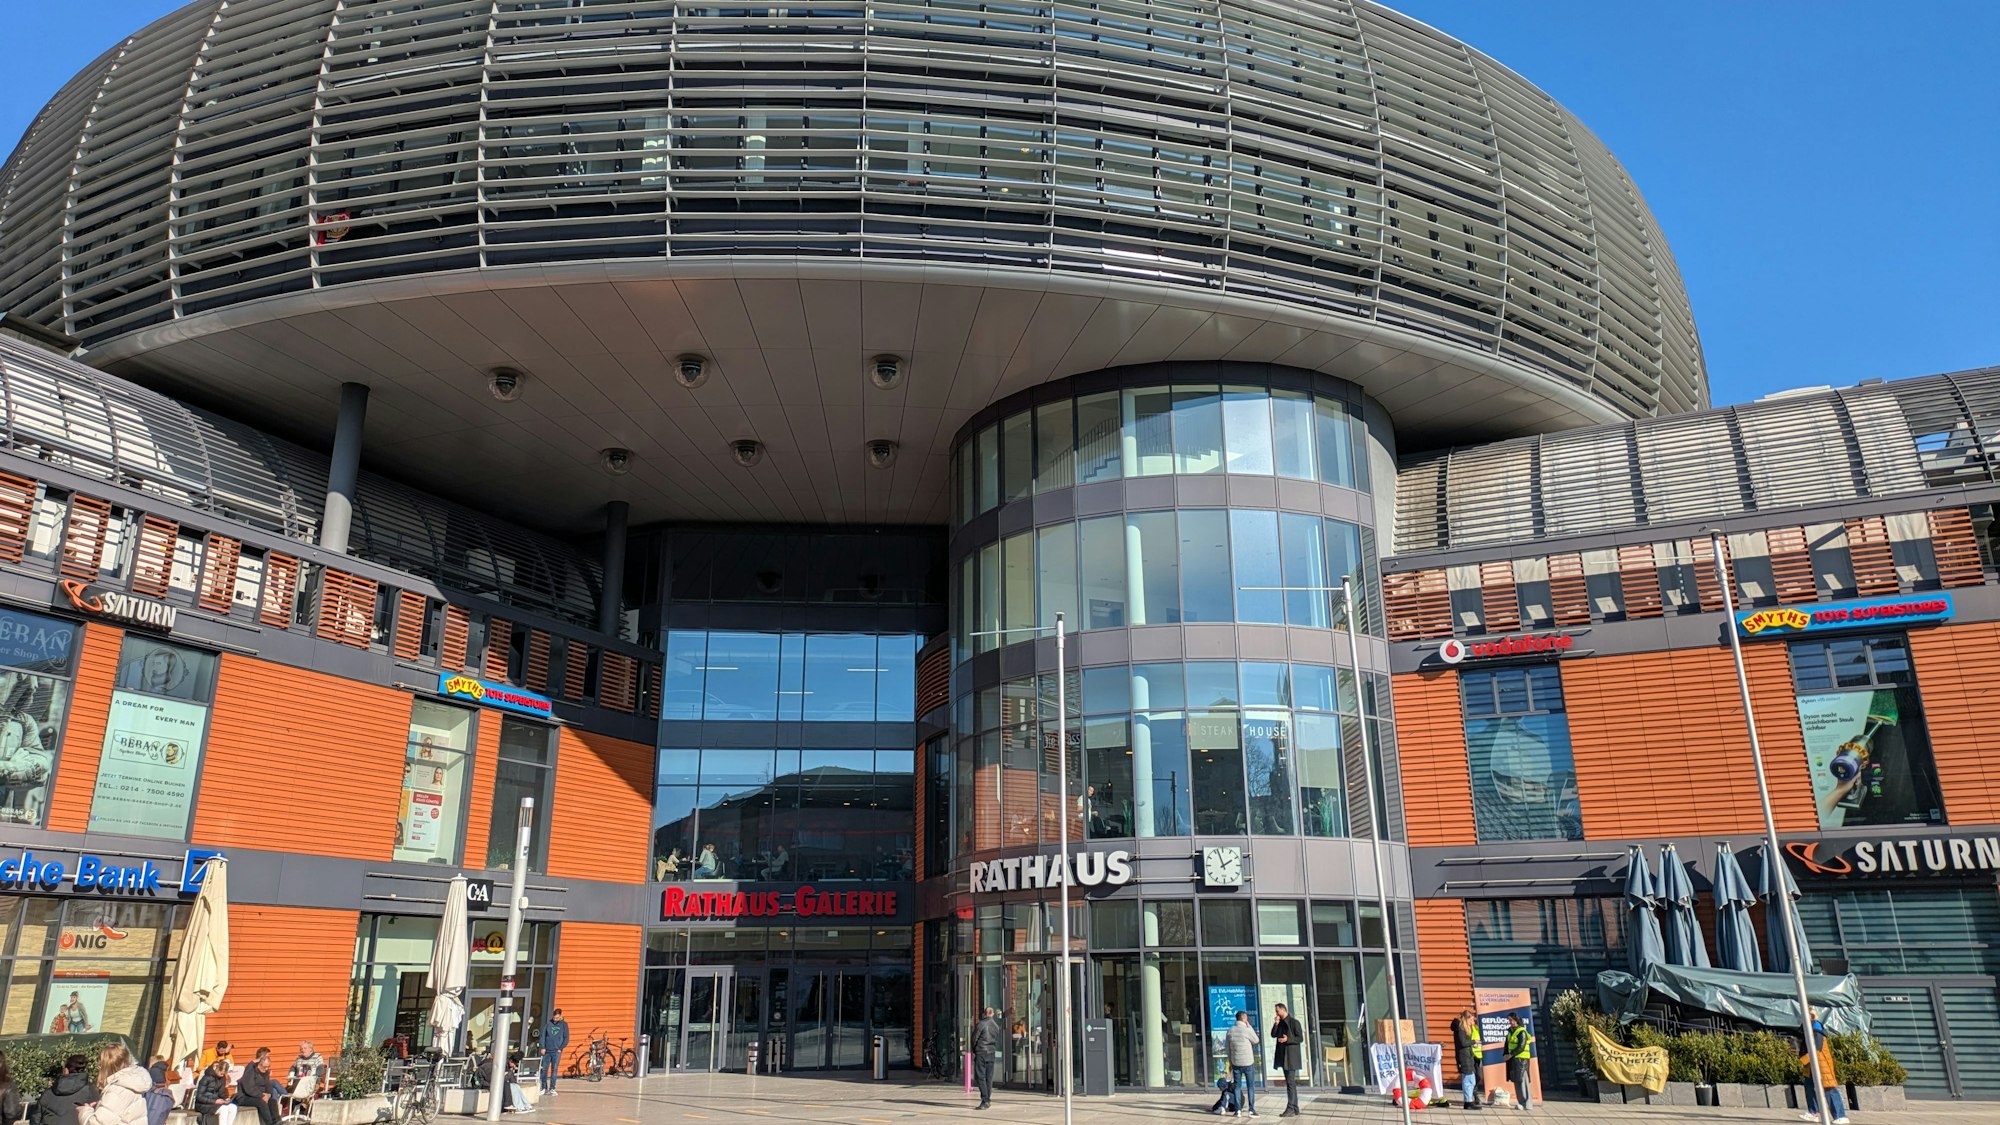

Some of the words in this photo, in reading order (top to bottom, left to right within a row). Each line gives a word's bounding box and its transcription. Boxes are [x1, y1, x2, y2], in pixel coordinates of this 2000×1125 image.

[103, 591, 177, 627] SATURN
[1743, 610, 1810, 631] SMYTHS
[1815, 609, 1849, 623] TOYS
[1852, 599, 1948, 619] SUPERSTORES
[13, 647, 39, 661] Shop
[1471, 634, 1574, 656] vodafone
[447, 678, 484, 698] SMYTHS
[122, 700, 148, 710] DREAM
[155, 715, 178, 724] EVERY
[180, 719, 195, 727] MAN
[1200, 724, 1233, 736] STEAK
[1249, 726, 1286, 737] HOUSE
[1805, 717, 1838, 725] unsichtbaren
[120, 737, 159, 752] BERAN
[98, 782, 118, 790] TEL.:
[146, 788, 165, 796] 7500
[1855, 837, 2000, 873] SATURN
[74, 855, 161, 890] Bank
[970, 850, 1133, 893] RATHAUS
[467, 882, 489, 902] C&A
